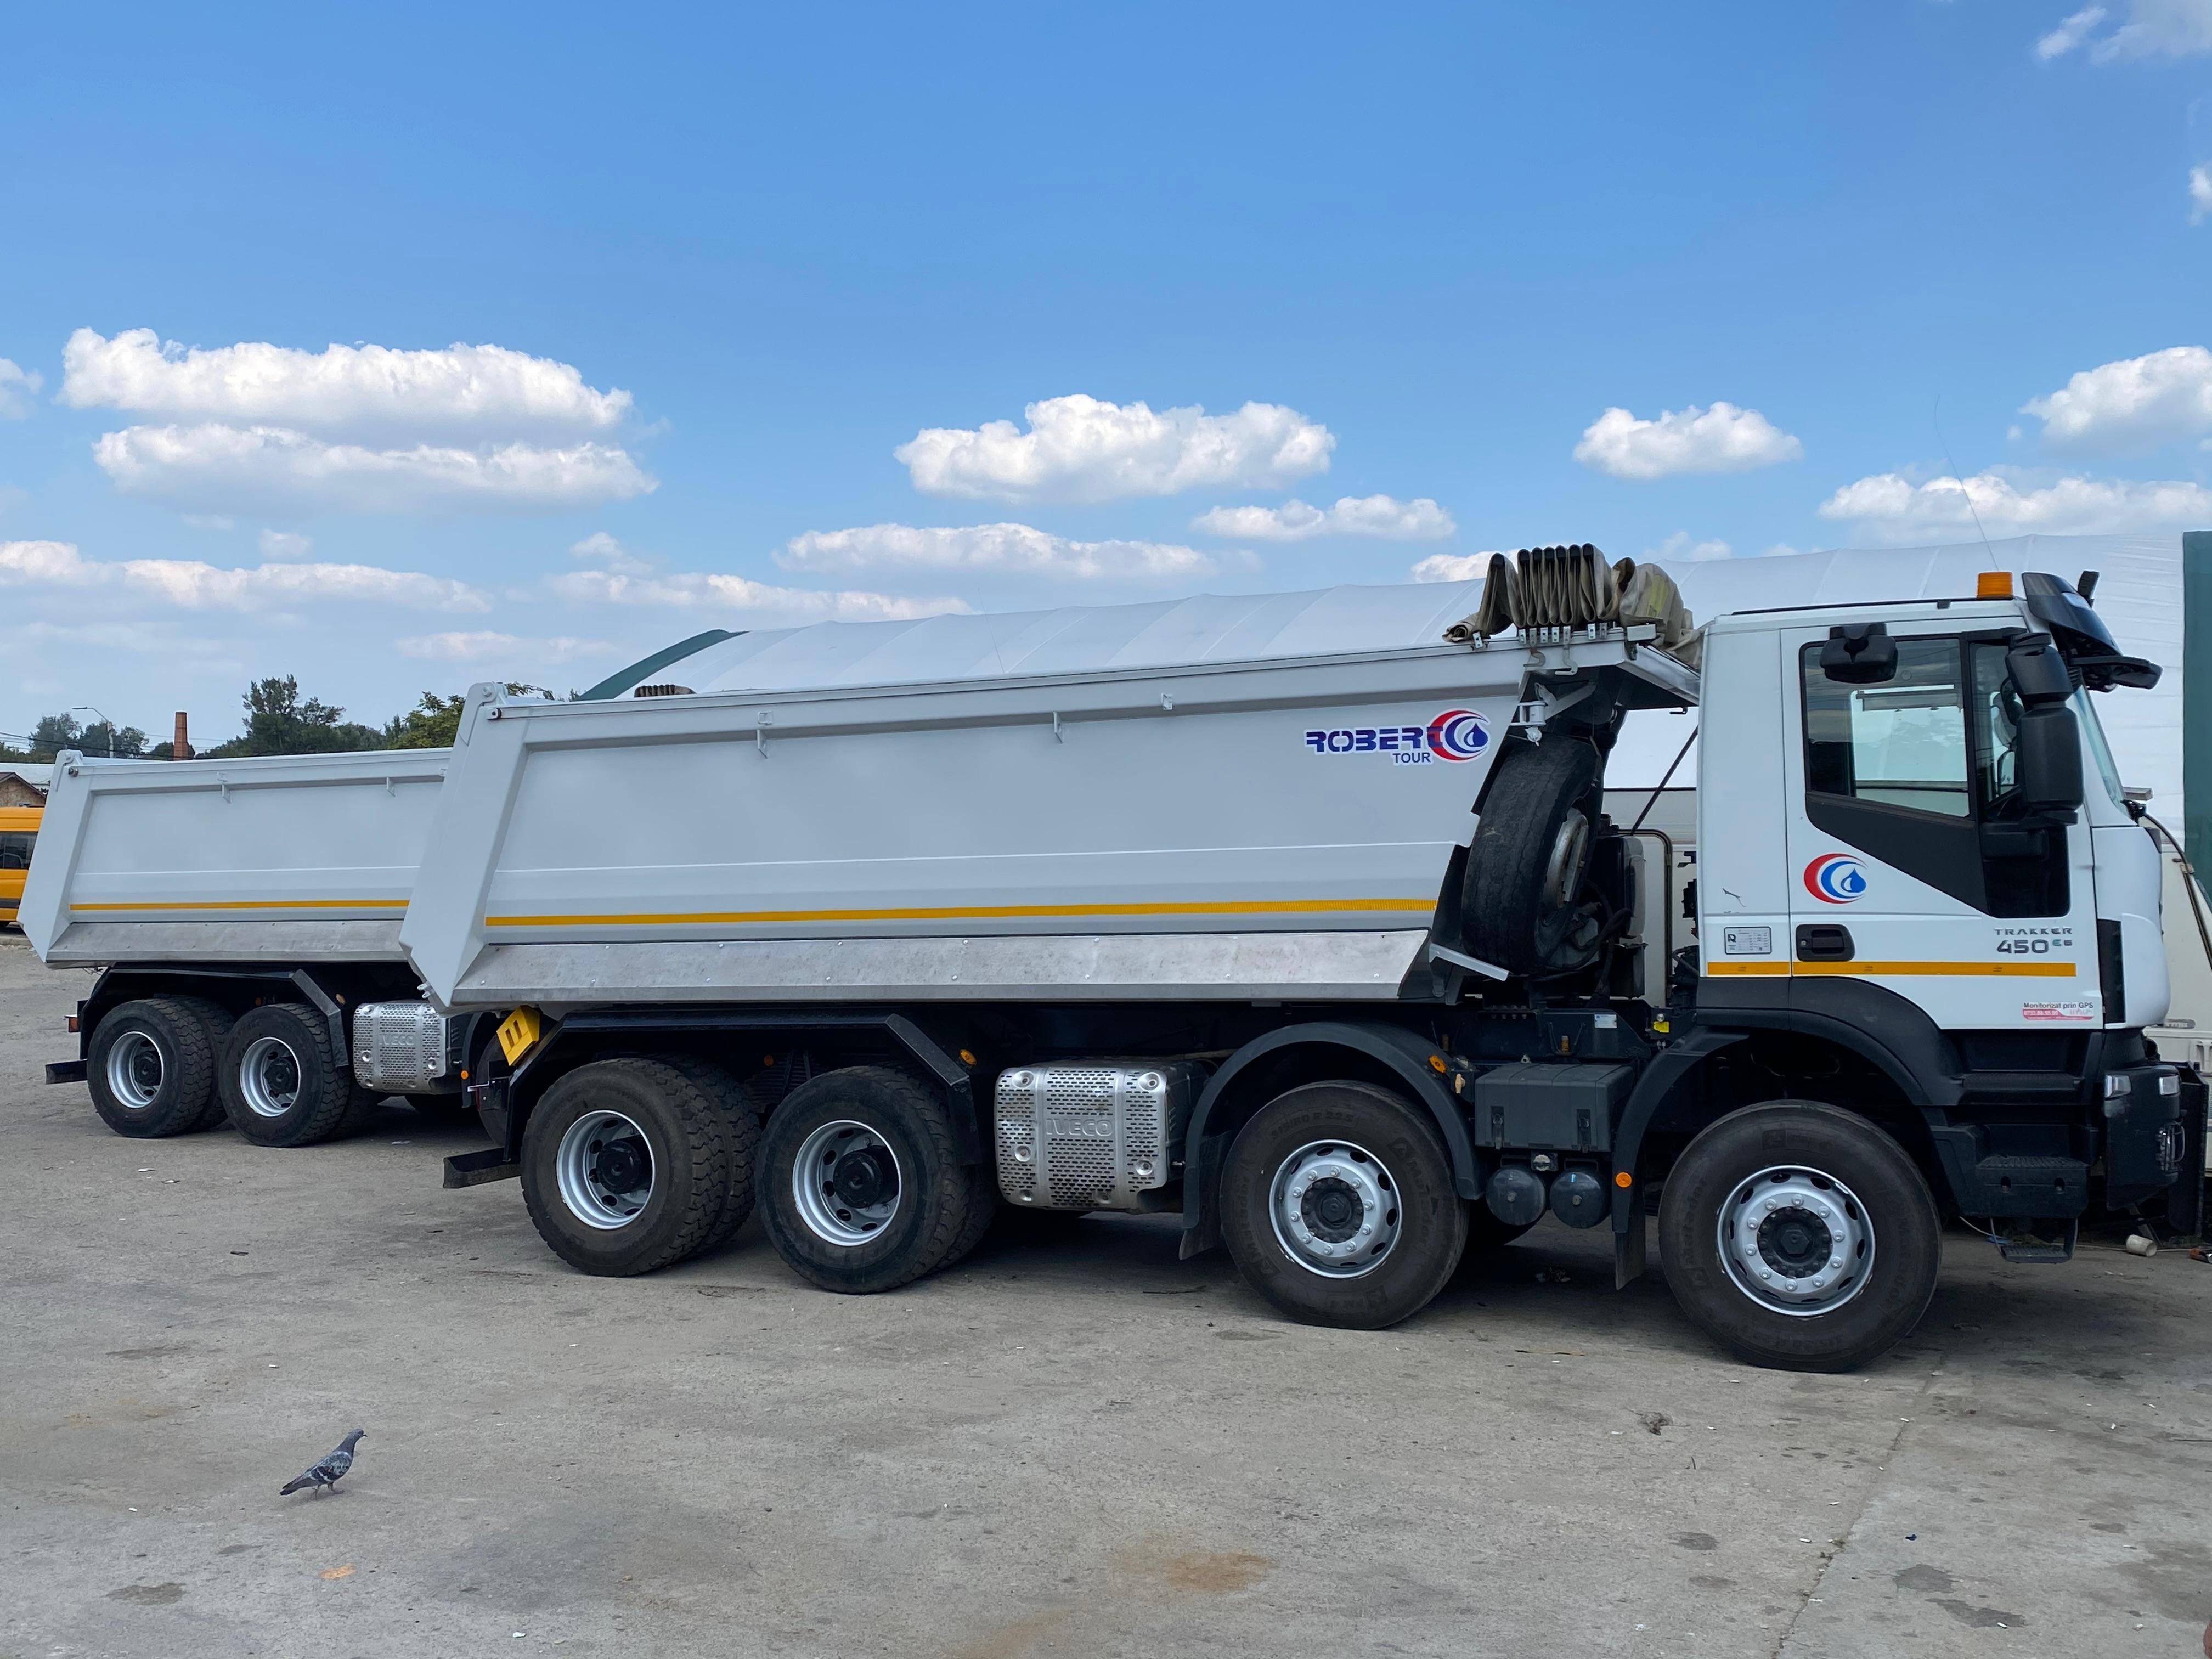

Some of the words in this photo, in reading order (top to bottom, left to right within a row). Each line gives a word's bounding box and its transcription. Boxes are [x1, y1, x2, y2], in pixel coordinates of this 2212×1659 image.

[1393, 752, 1430, 764] TOUR
[1996, 939, 2049, 953] 450
[1046, 1118, 1113, 1137] IVECO
